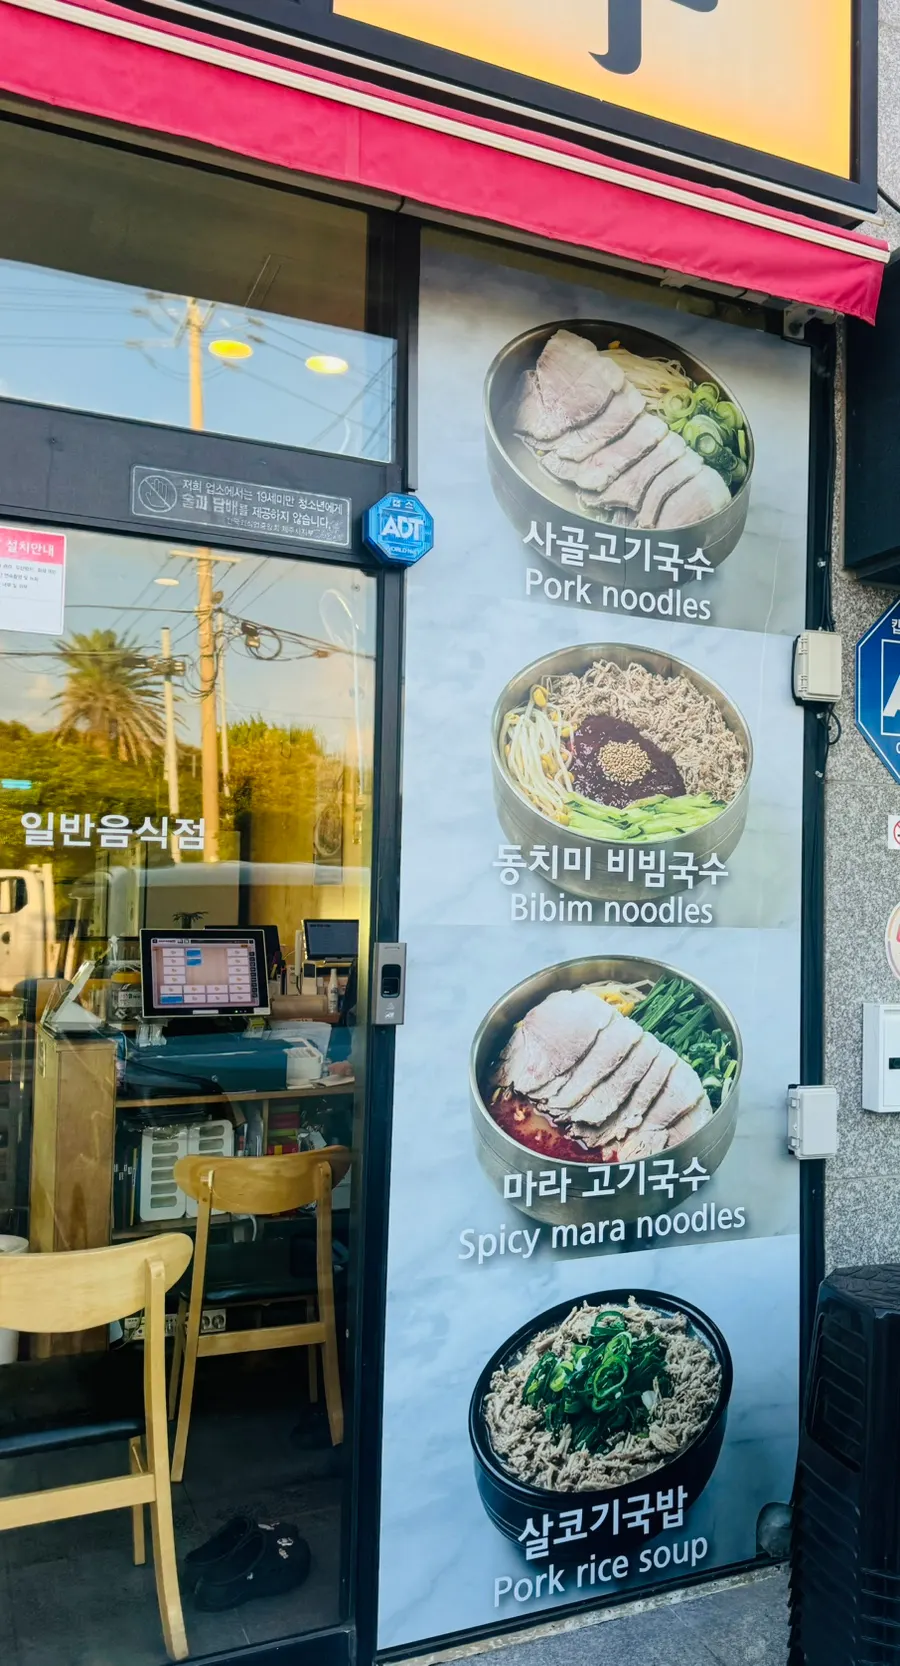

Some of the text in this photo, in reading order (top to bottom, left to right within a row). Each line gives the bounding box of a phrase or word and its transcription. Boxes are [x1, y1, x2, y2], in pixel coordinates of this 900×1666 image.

[182, 479, 343, 515] 저희 업소에서는 19세미만 청소년에게
[182, 493, 331, 529] 술과 담배를 제공하지 않습니다.
[7, 539, 54, 557] 설치안내
[381, 514, 425, 541] ADT
[522, 520, 715, 582] 사골고기국수
[525, 567, 712, 621] Pork noodles
[20, 812, 206, 850] 일반음식점
[492, 844, 729, 890] 동치미 비빔국수
[510, 892, 713, 924] Bibim noodles
[503, 1156, 711, 1207] 마라 고기국수
[458, 1203, 746, 1265] Spicy mara noodles
[518, 1485, 689, 1561] 살코기국밥
[494, 1536, 708, 1608] Pork rice soup
